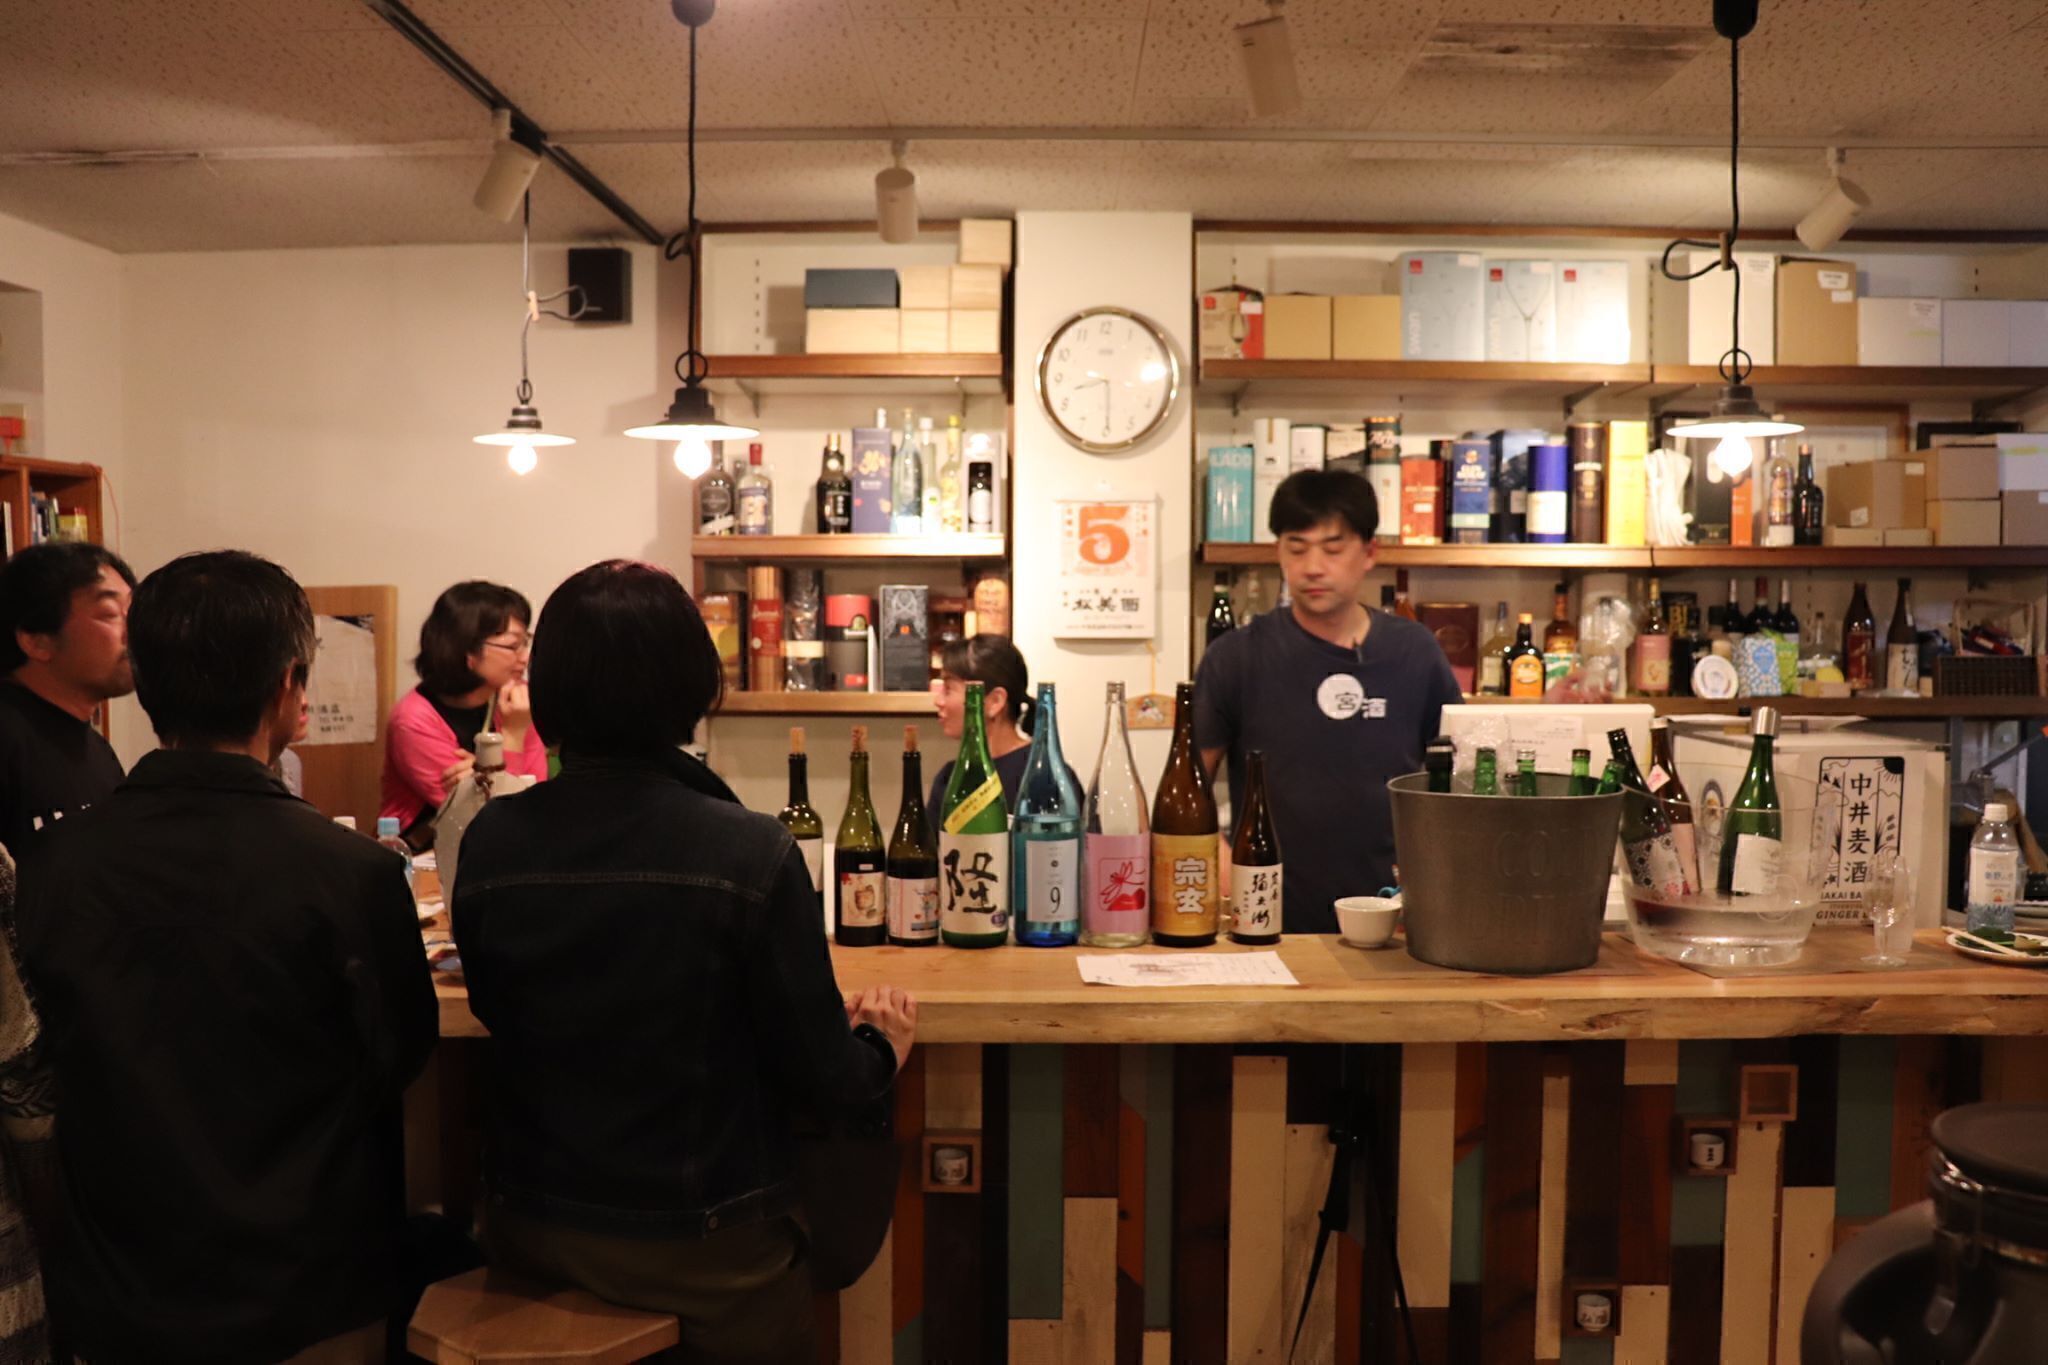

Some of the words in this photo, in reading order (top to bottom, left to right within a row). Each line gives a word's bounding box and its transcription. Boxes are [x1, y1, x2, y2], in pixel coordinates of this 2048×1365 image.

[1078, 505, 1130, 565] 5
[1844, 772, 1872, 884] 中井麦酒
[1050, 886, 1061, 914] 9
[1173, 855, 1207, 914] 宗玄
[1816, 910, 1859, 919] GINGER
